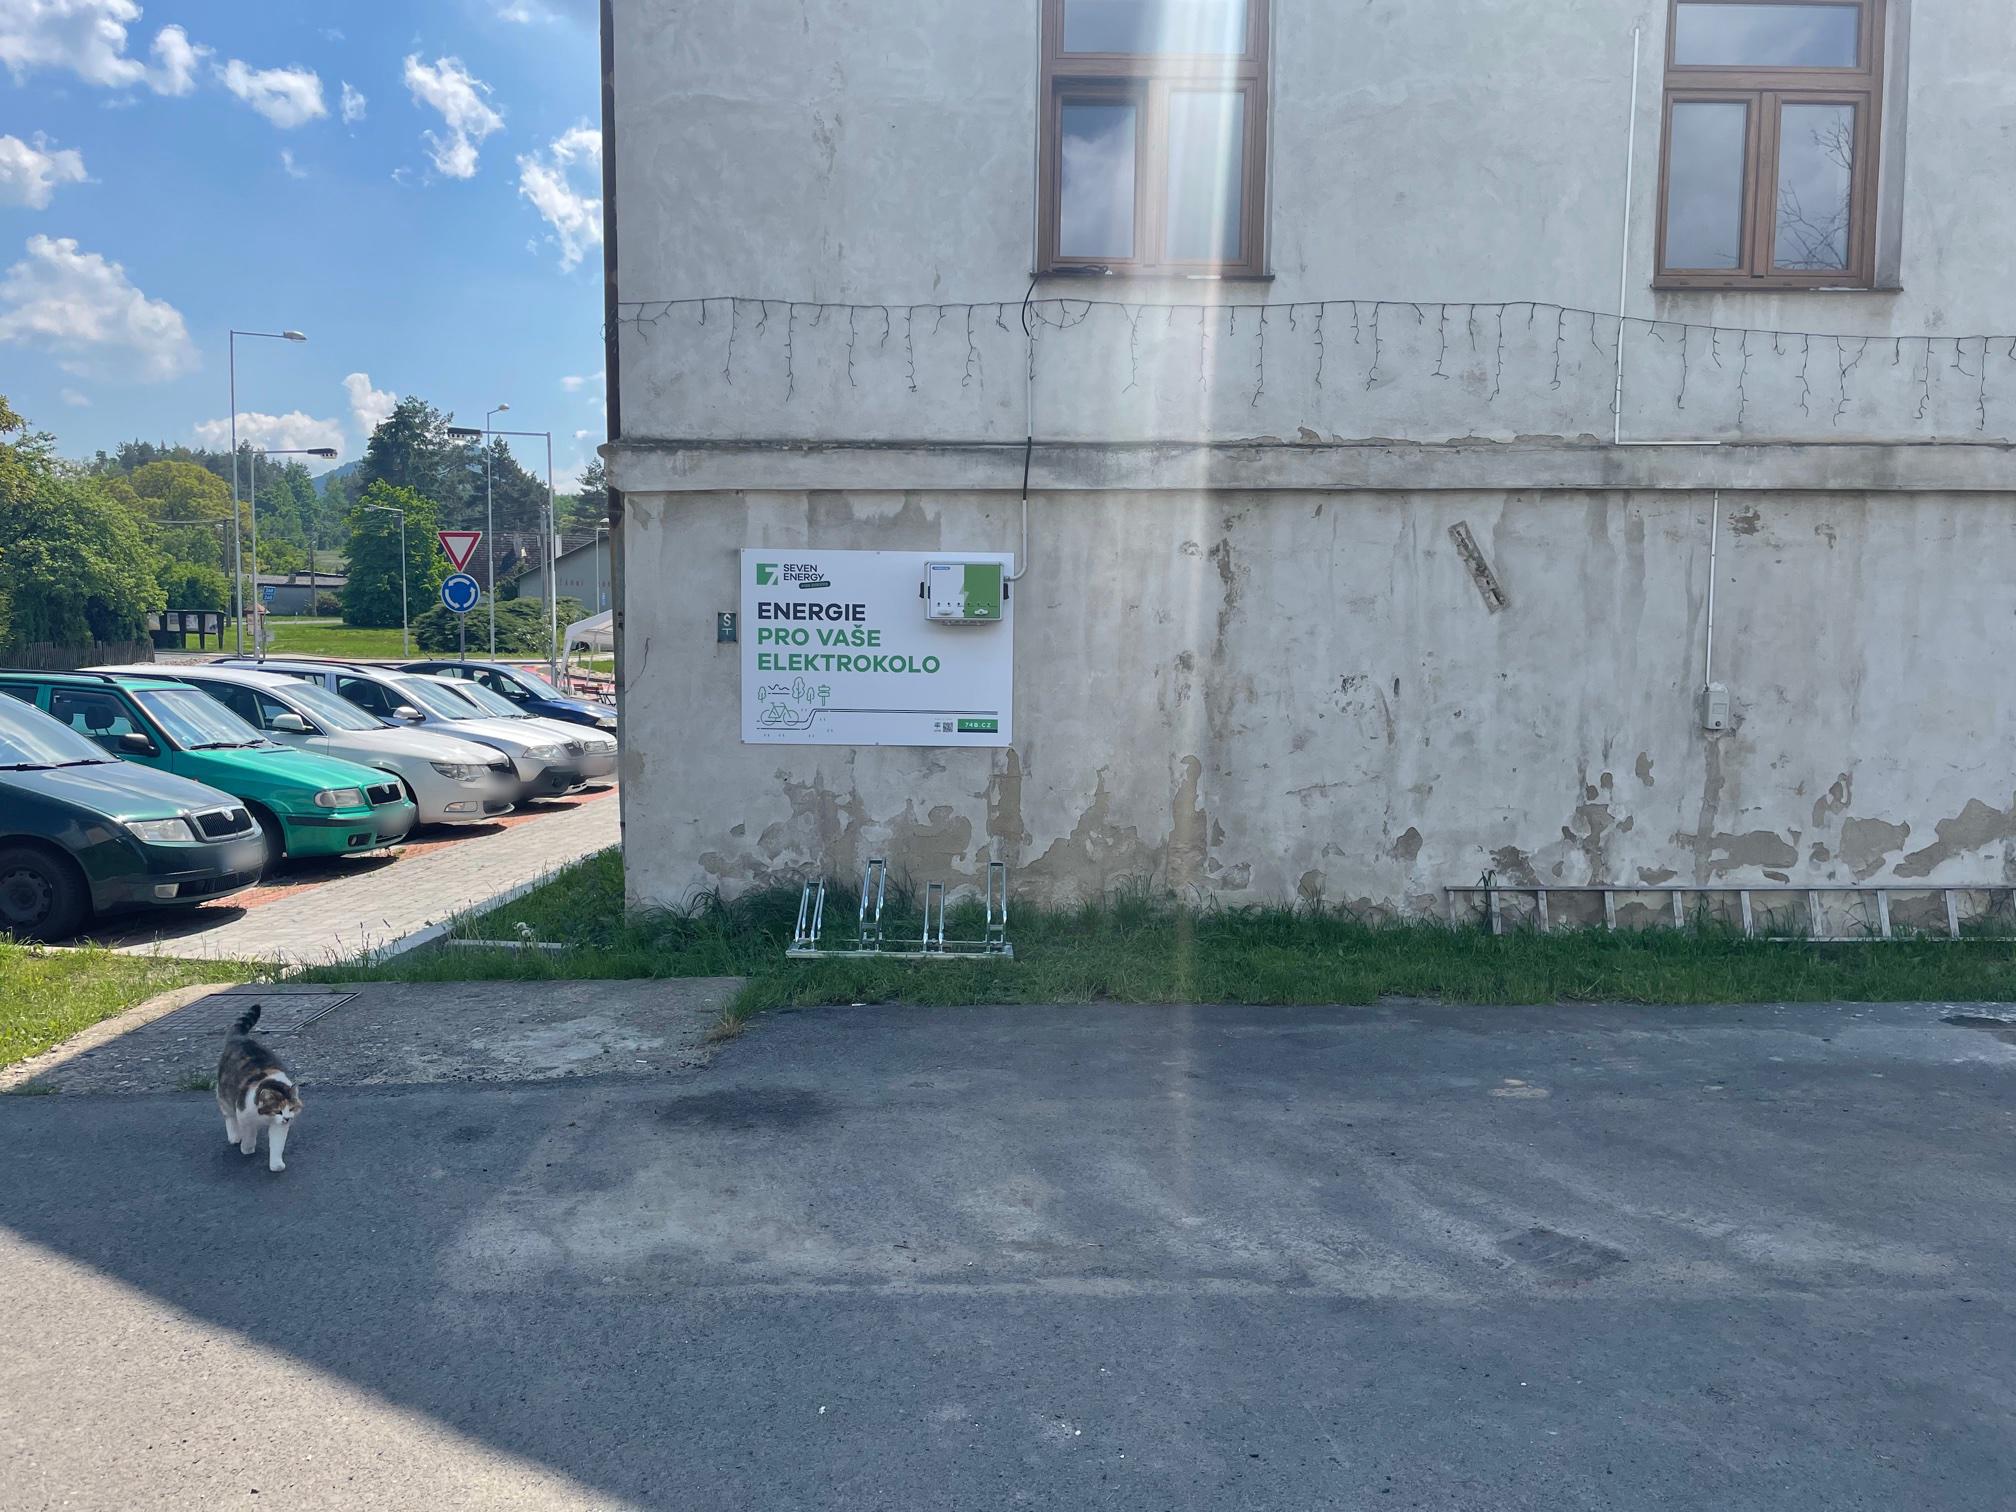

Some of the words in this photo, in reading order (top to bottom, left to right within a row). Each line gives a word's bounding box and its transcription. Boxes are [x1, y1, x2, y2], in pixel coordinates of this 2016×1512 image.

[783, 563, 818, 573] SEVEN
[783, 572, 825, 581] ENERGY
[757, 601, 866, 621] ENERGIE
[757, 627, 810, 646] PRO
[816, 624, 882, 647] VAŠE
[757, 652, 941, 674] ELEKTROKOLO
